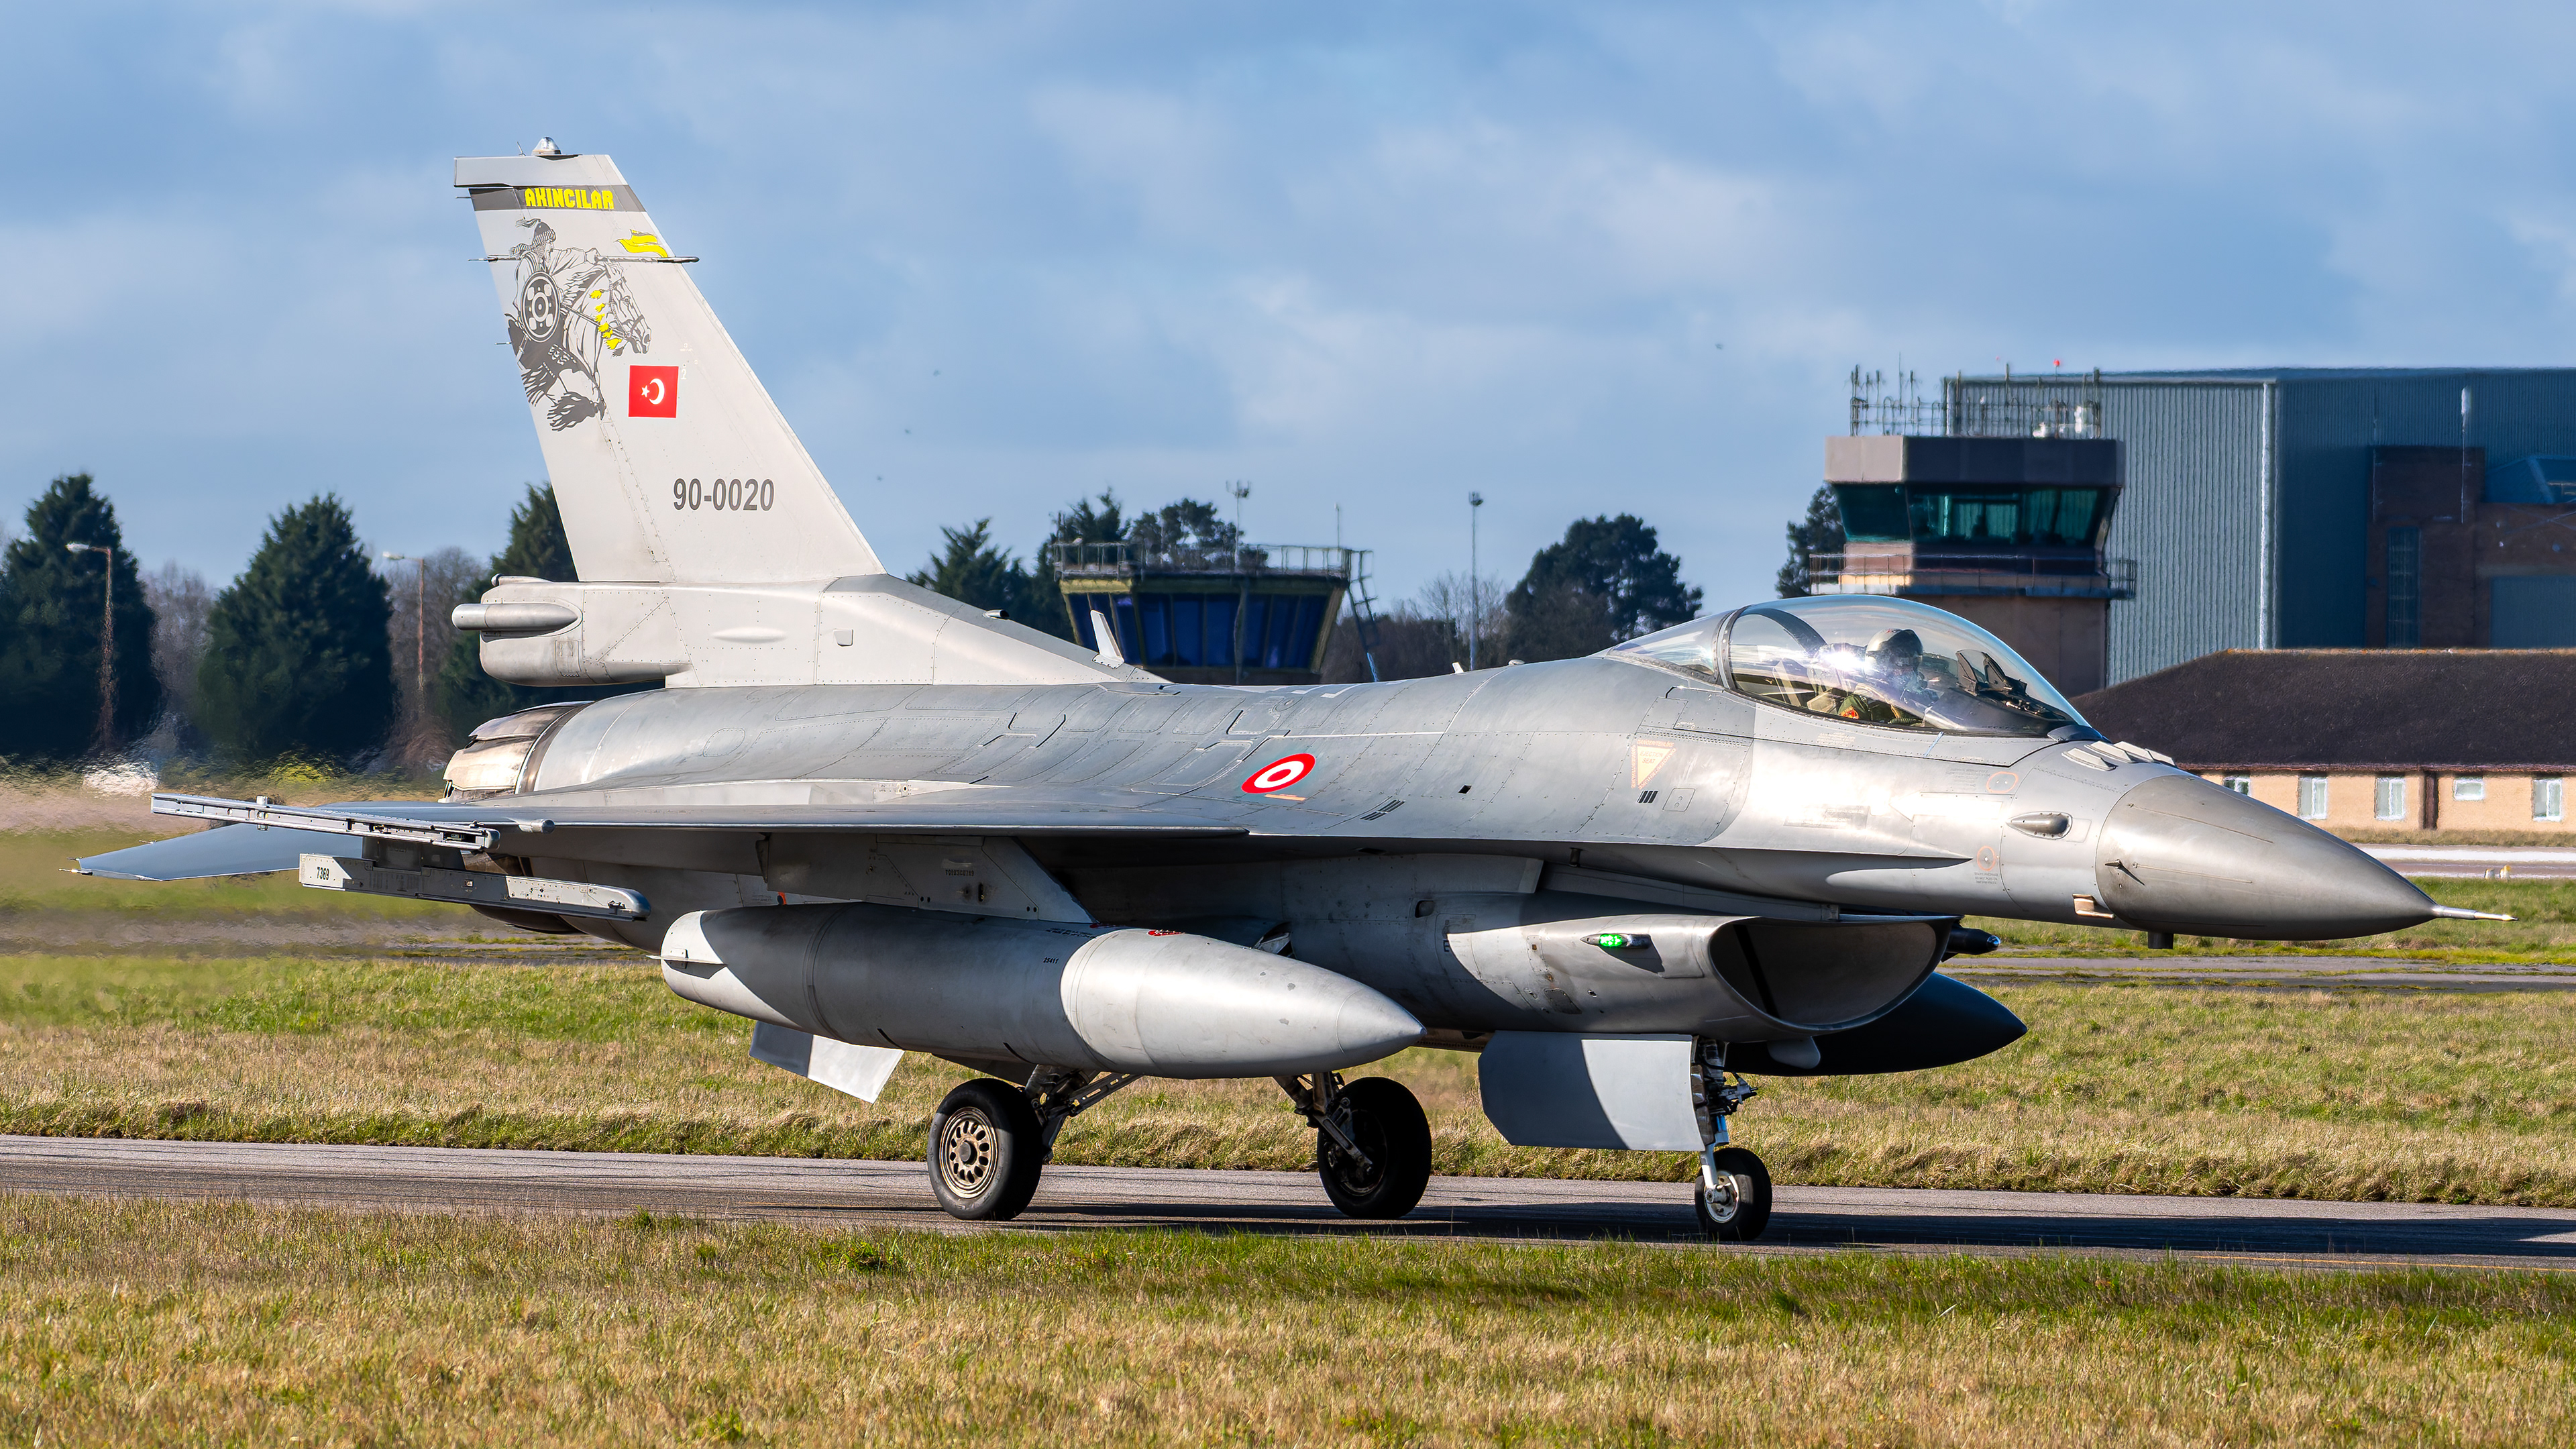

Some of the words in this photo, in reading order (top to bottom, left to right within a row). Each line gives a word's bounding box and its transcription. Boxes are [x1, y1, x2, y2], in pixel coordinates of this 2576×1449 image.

[525, 188, 614, 210] AKINCILAR
[673, 478, 775, 511] 90-0020
[317, 866, 329, 881] 7369
